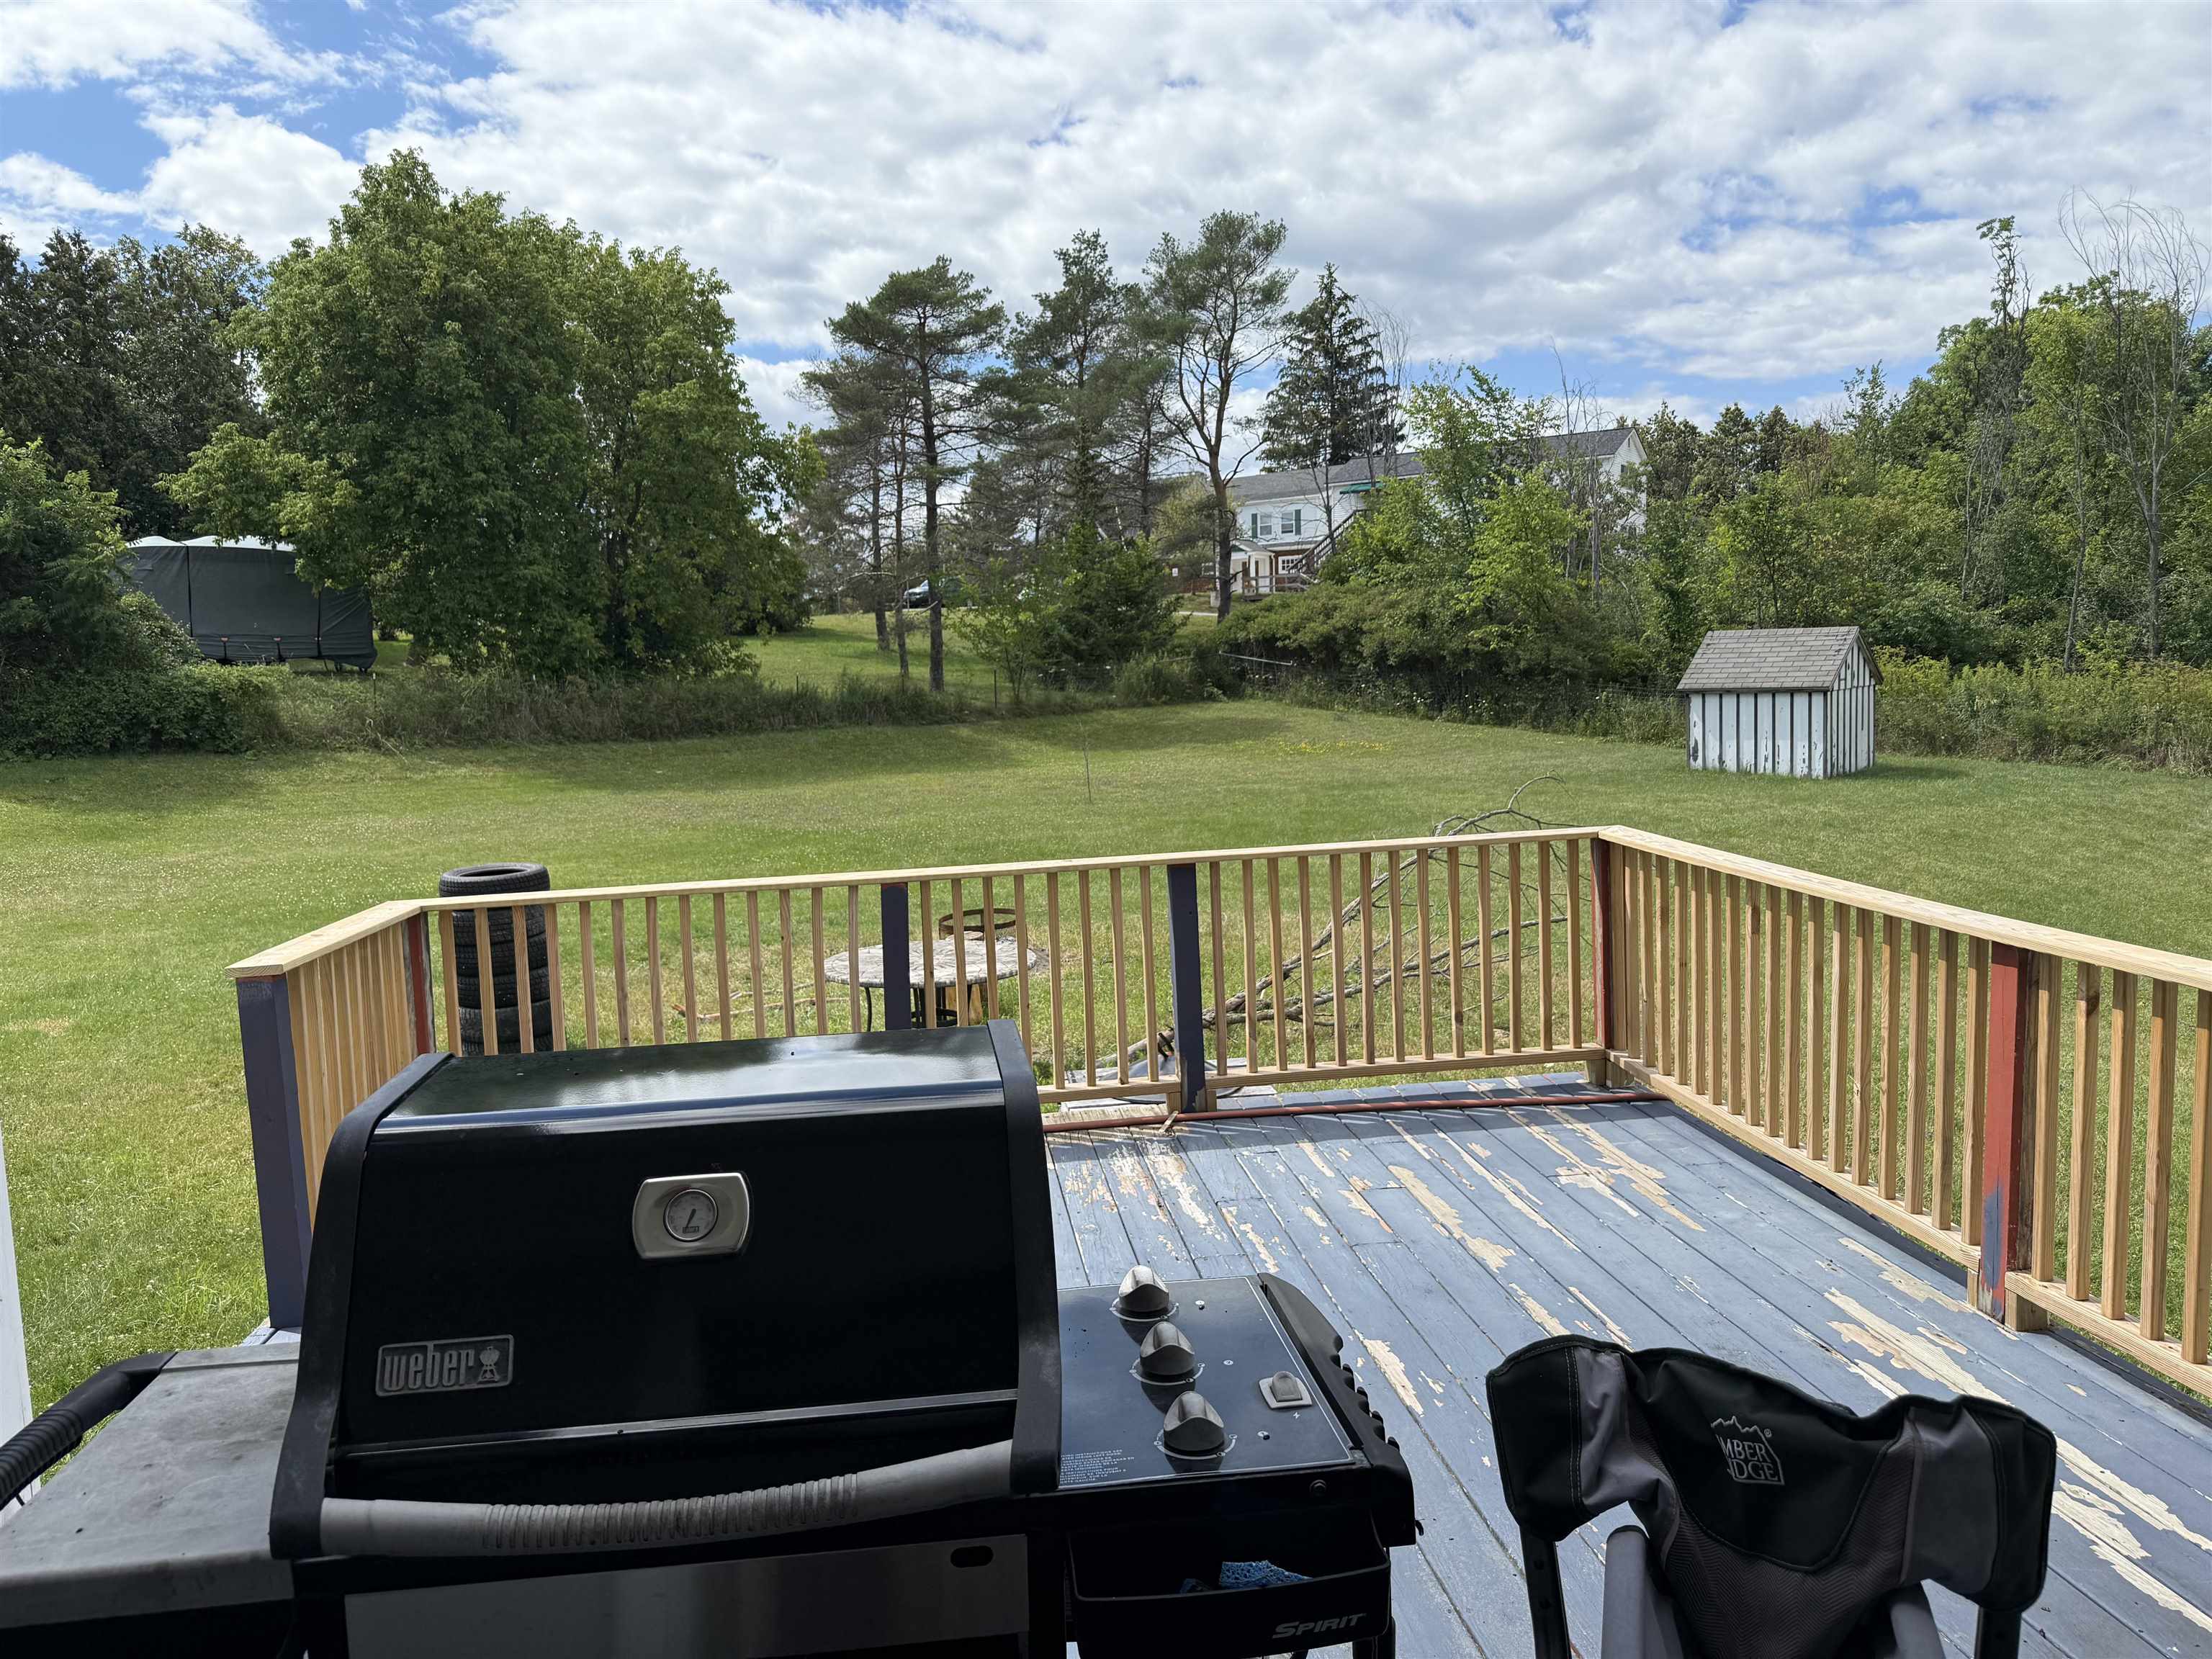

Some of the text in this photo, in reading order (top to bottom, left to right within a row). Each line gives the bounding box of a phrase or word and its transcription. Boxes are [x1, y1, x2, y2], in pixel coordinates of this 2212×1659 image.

[383, 1345, 475, 1391] weber
[1715, 1434, 1771, 1463] MBER
[1272, 1613, 1366, 1639] SPIRIT
